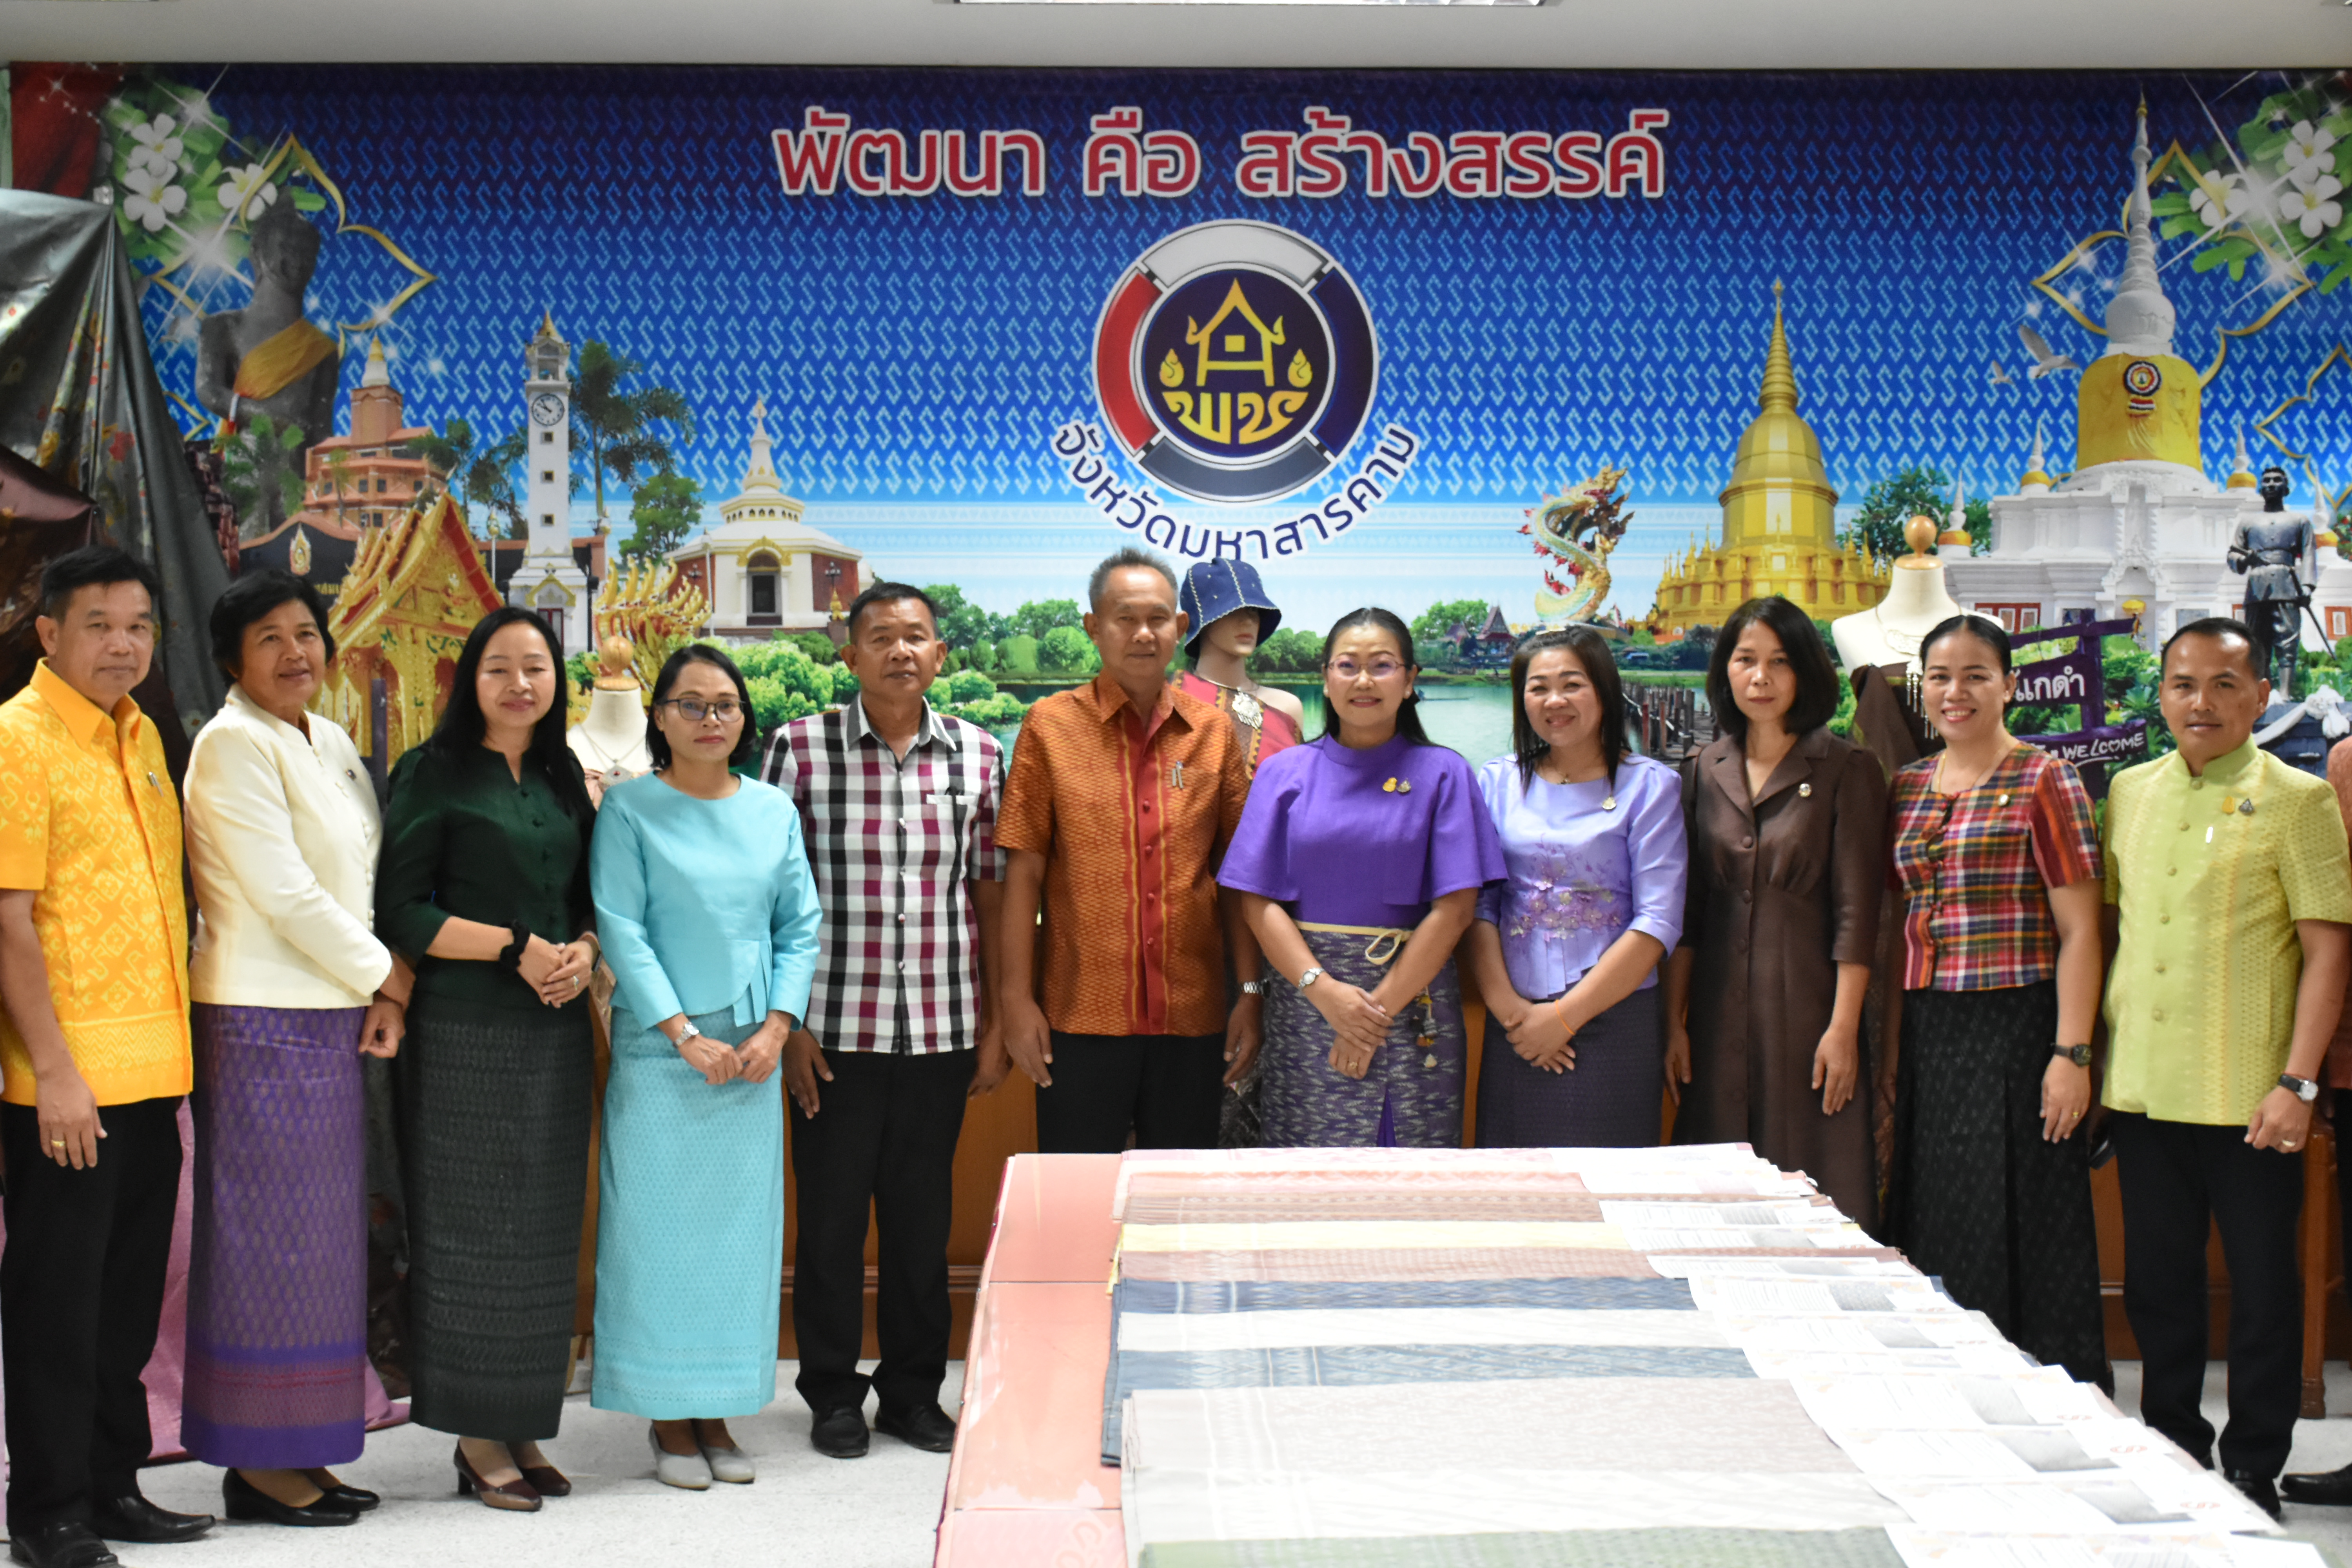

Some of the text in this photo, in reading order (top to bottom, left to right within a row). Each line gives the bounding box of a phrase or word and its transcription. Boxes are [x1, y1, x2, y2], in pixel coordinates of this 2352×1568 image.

[772, 107, 1668, 197] พัฒนา คือ สร้างสรรค์
[1054, 423, 1416, 560] จังหวัดมหาสารคาม
[2010, 666, 2085, 702] แกดำ
[2062, 732, 2145, 760] WELCOME
